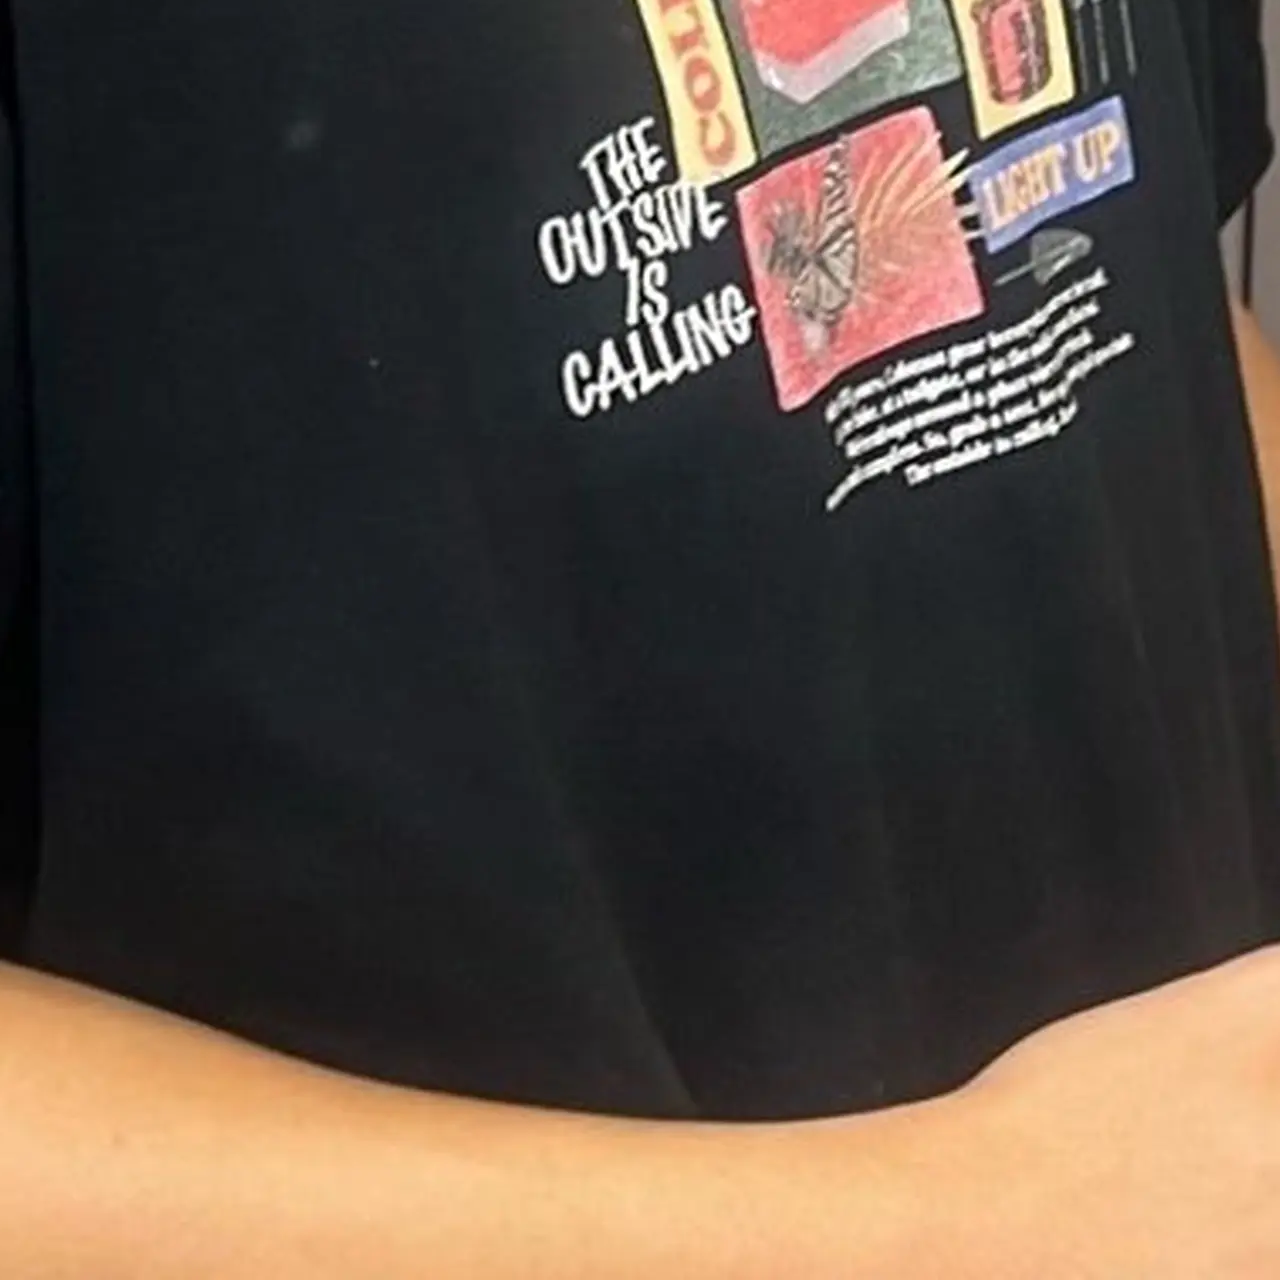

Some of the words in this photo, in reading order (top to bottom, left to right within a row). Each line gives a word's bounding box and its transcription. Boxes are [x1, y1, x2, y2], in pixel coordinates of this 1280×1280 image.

[579, 115, 668, 212] THE
[982, 142, 1067, 232] LIGHT
[1072, 119, 1122, 184] UP
[624, 255, 670, 328] IS
[561, 283, 758, 418] CALLING
